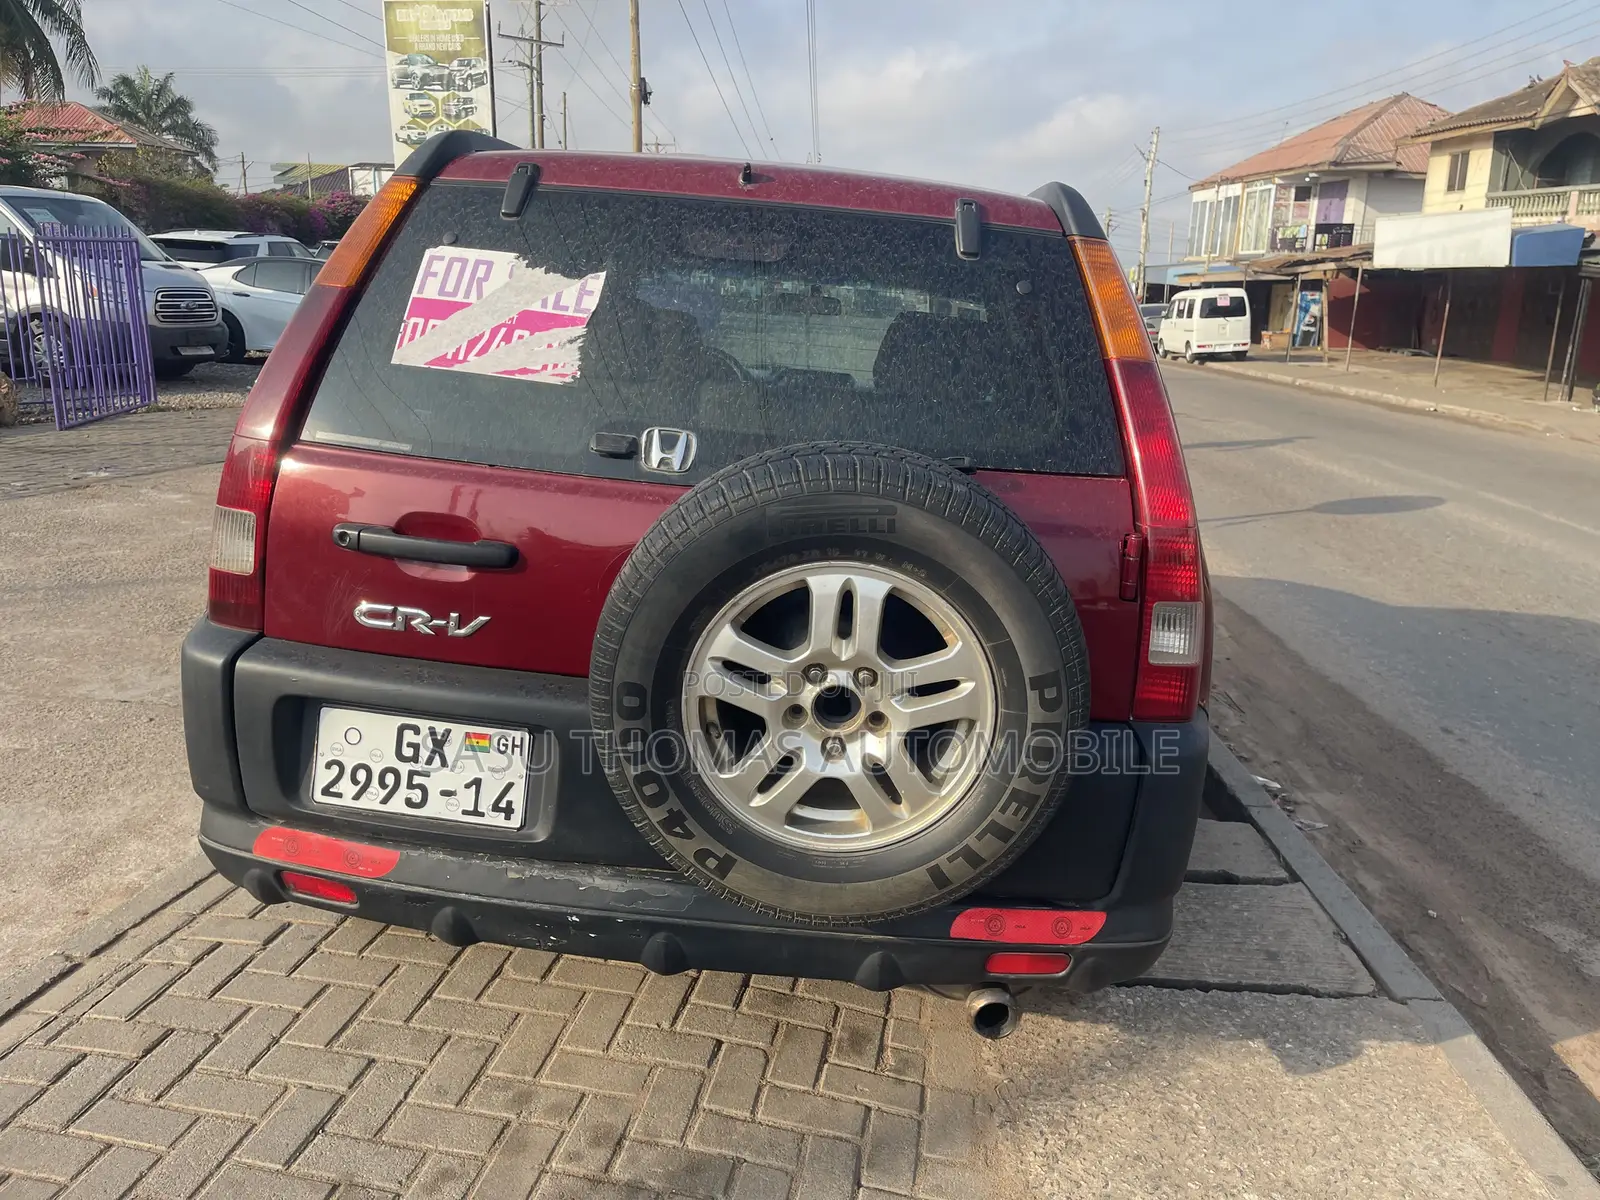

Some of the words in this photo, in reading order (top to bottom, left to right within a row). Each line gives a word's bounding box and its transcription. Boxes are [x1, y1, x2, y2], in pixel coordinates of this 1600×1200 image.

[417, 254, 495, 300] FOR
[508, 263, 600, 314] LE
[353, 601, 492, 637] CR-V
[394, 723, 452, 768] GX
[496, 734, 524, 757] GH
[321, 758, 516, 821] 2995-14
[616, 681, 738, 881] P4000
[925, 670, 1063, 891] PIRELLI
